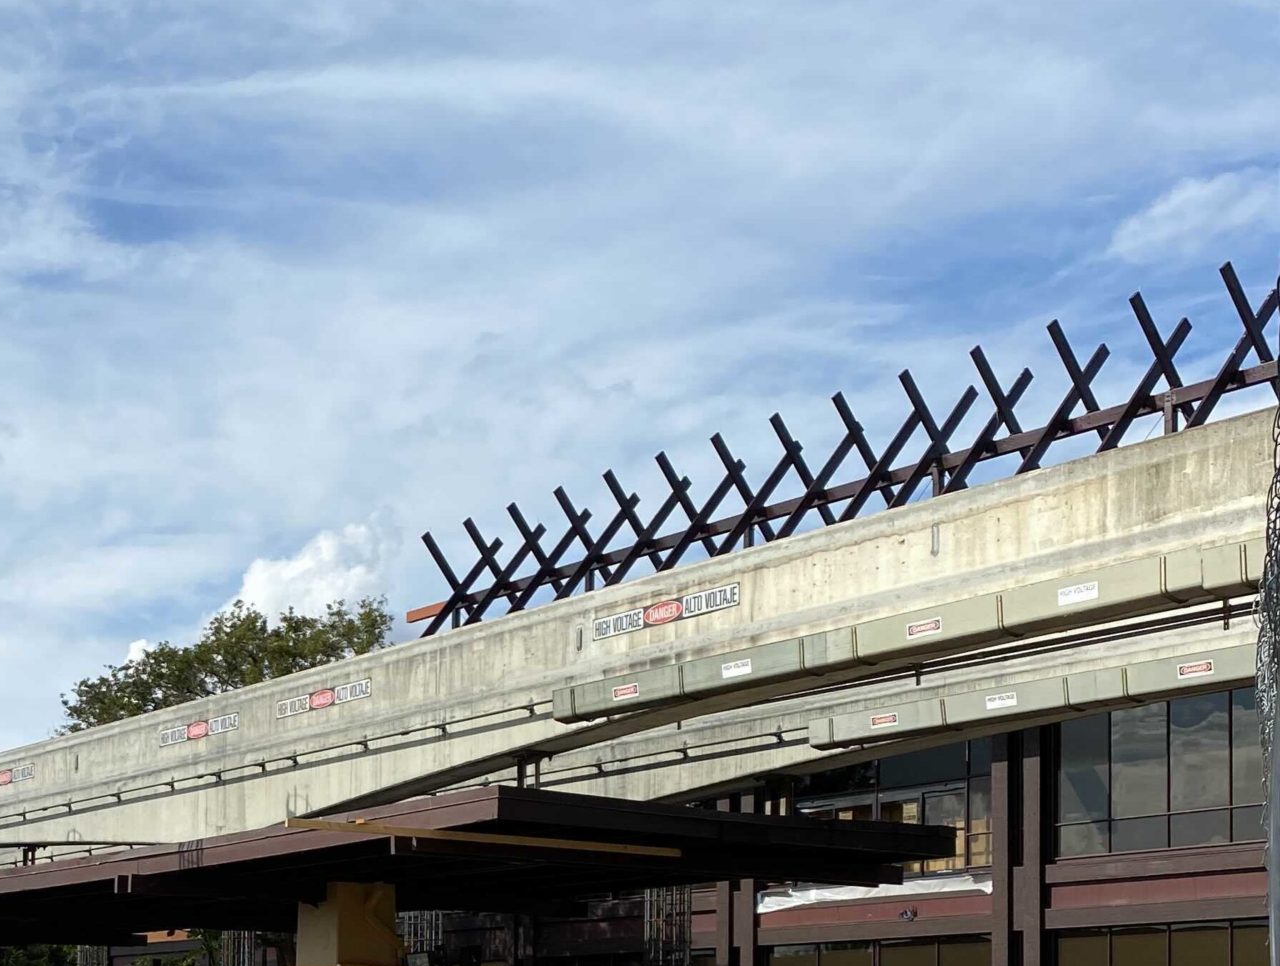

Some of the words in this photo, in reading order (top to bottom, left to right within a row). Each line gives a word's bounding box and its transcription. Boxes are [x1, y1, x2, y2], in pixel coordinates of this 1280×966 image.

[595, 619, 611, 637] HIGH
[612, 611, 642, 633] VOLTAGE
[649, 604, 677, 622] DANGER
[685, 596, 703, 614] ALTO
[705, 586, 738, 608] VOLTAJE
